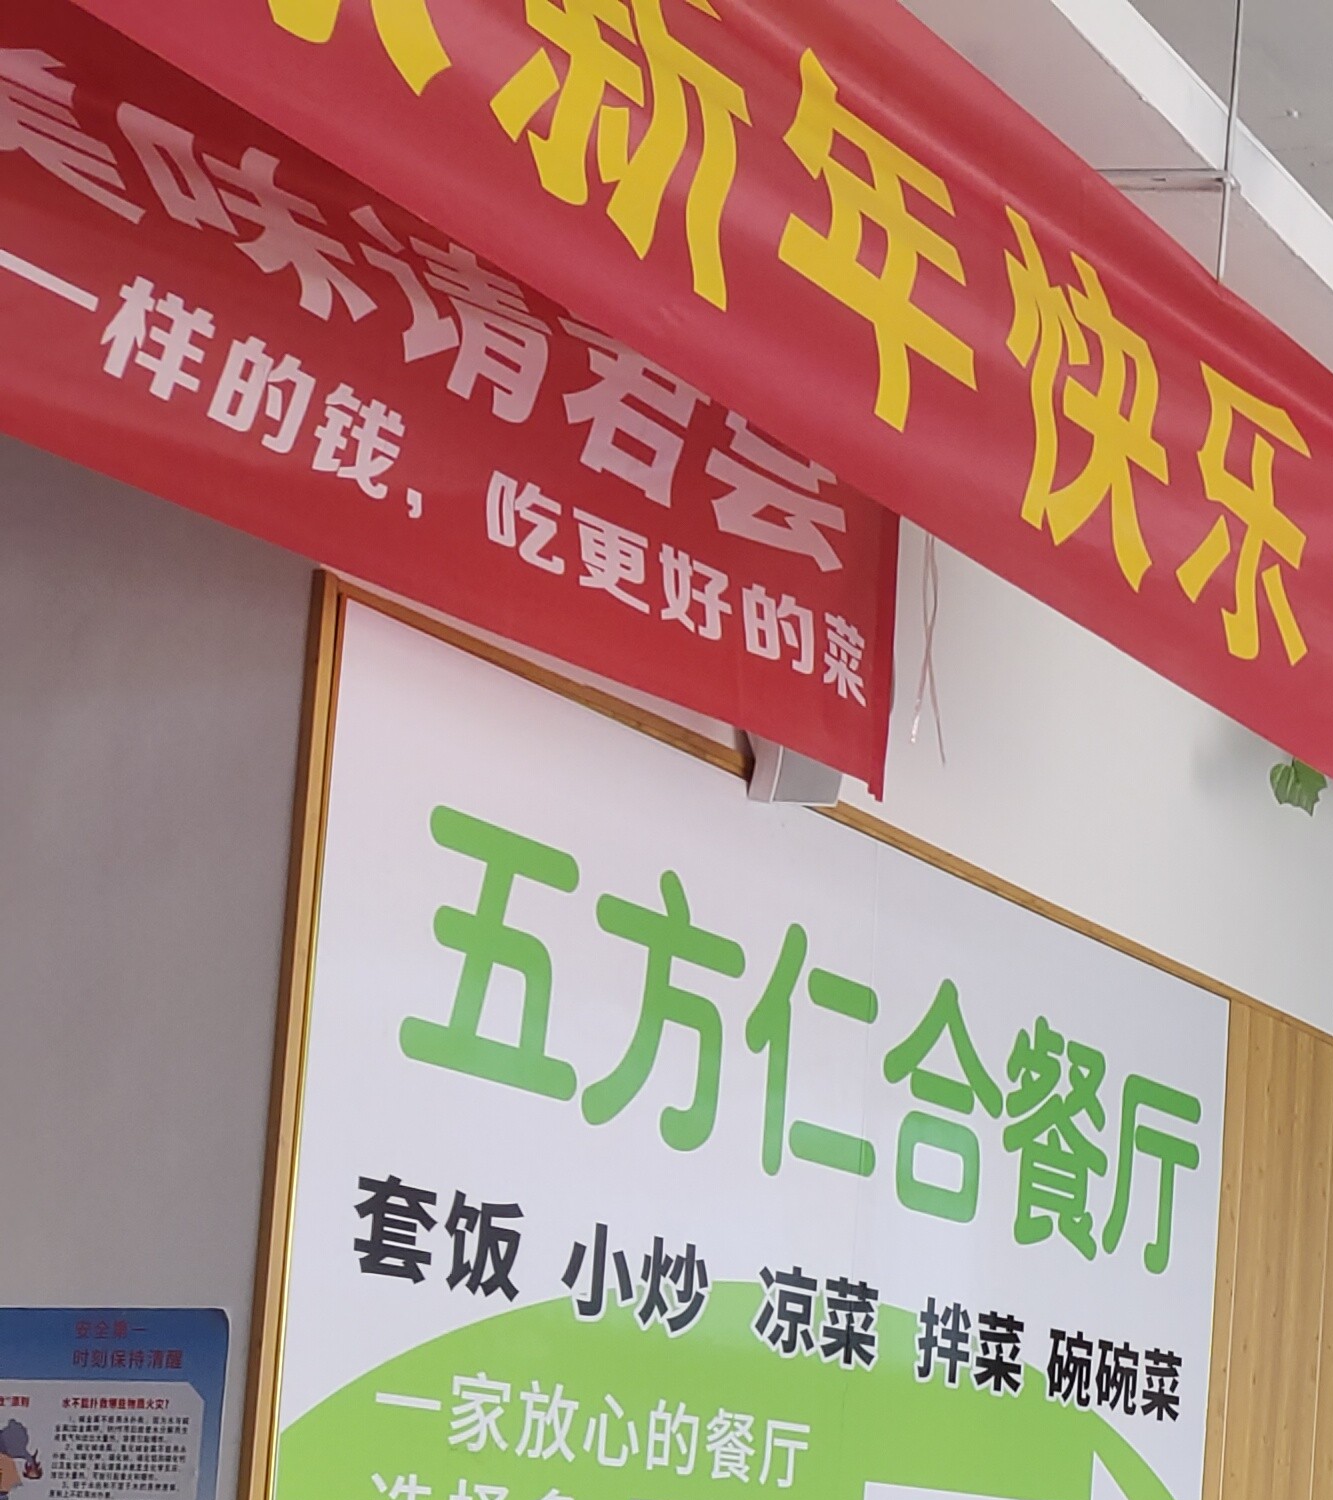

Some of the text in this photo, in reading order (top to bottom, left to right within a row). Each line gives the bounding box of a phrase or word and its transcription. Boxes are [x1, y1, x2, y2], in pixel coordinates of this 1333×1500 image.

[399, 805, 1203, 1274] 五方仁合餐厅
[75, 1320, 148, 1339] 安全第一
[353, 1174, 1182, 1420] 套饭 小炒 凉菜 拌菜 碗碗菜
[73, 1349, 183, 1369] 时刻保持清醒
[374, 1373, 811, 1490] 一家放心的餐厅
